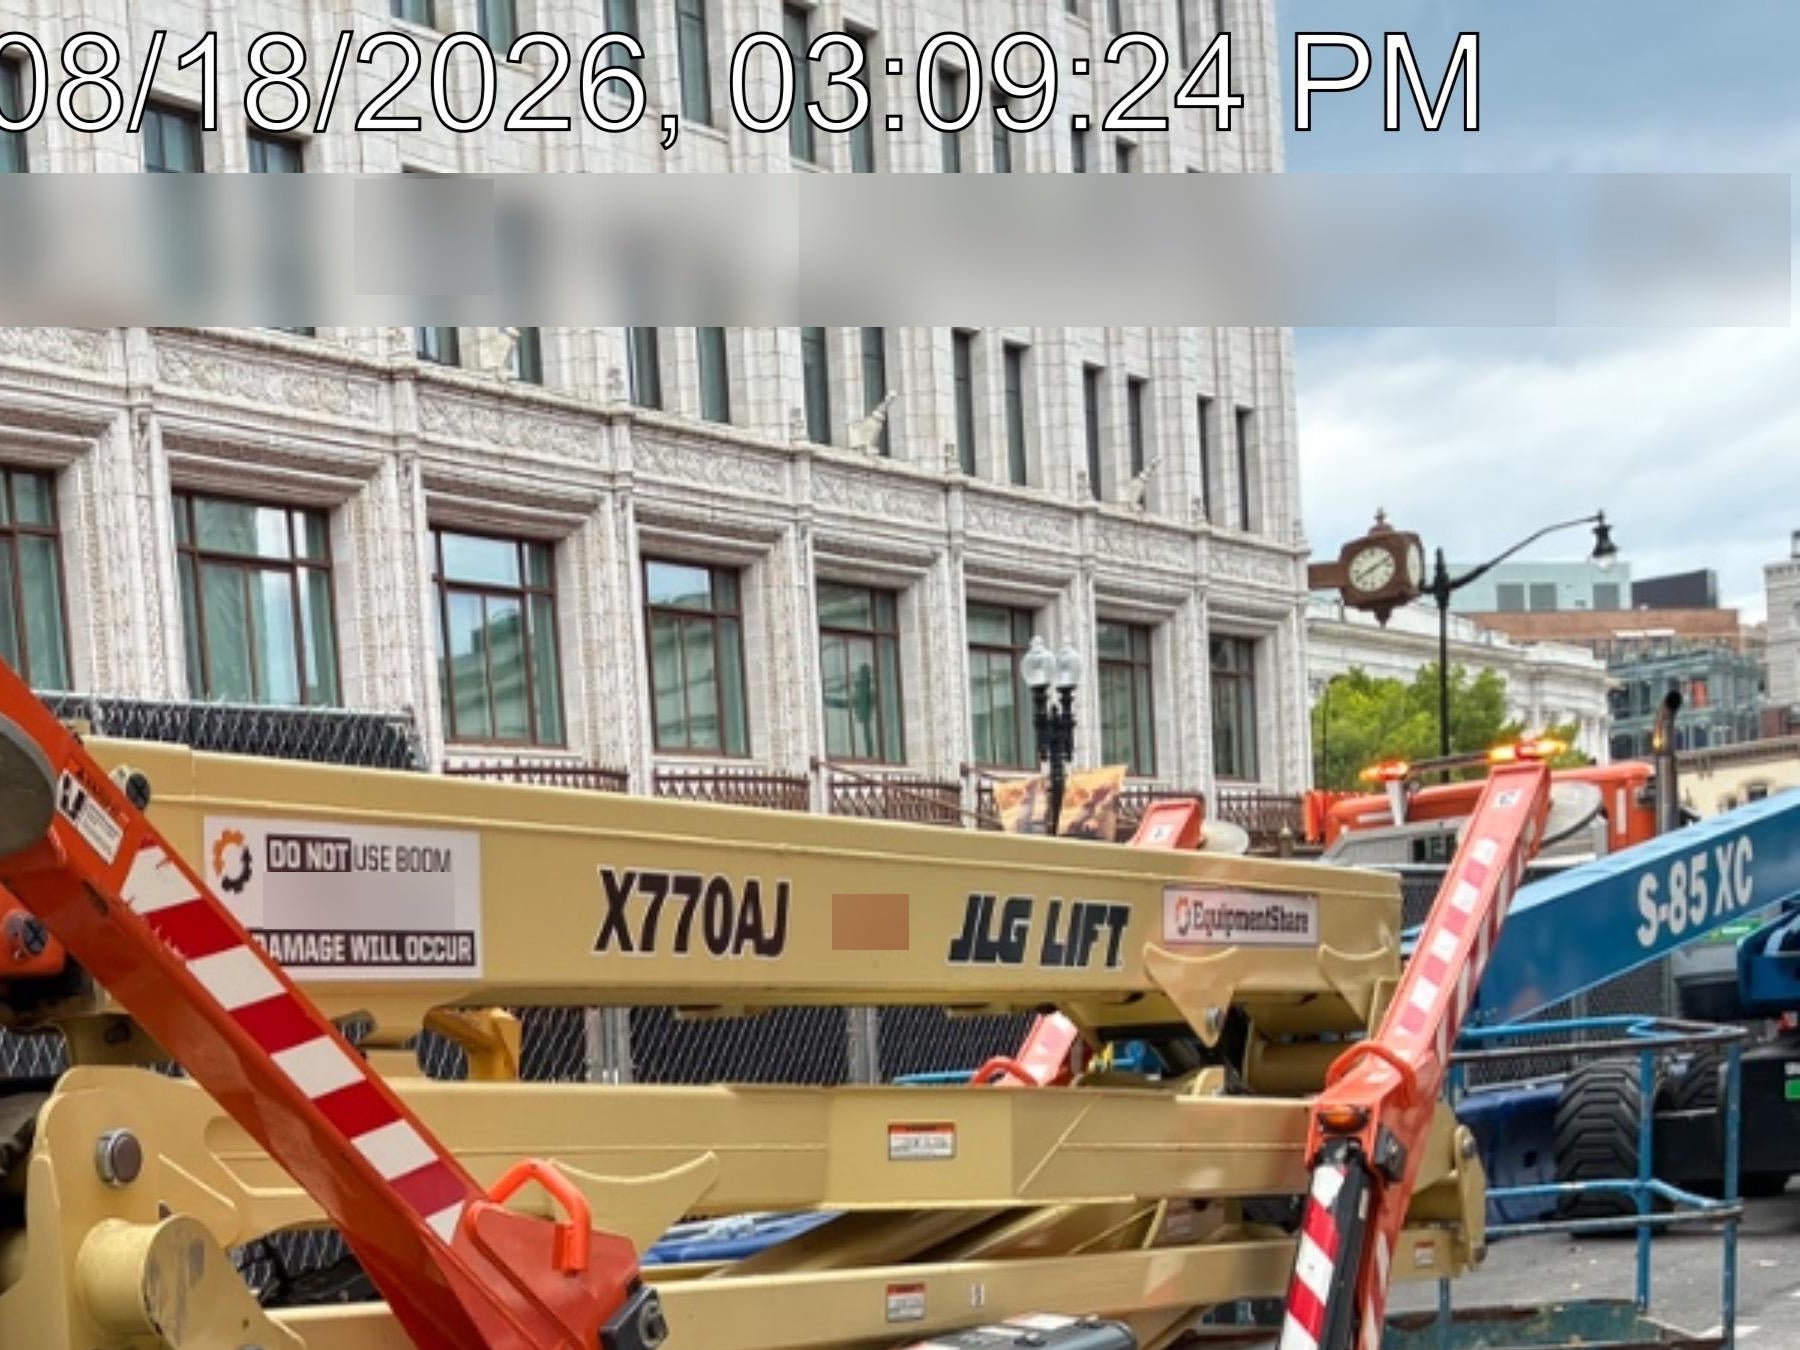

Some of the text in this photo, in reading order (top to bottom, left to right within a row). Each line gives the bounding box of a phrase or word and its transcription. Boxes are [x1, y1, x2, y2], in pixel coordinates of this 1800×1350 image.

[269, 839, 451, 873] DO NOT USE BOOM
[592, 865, 790, 961] X770AJ
[1192, 900, 1309, 938] EquipmentShare
[1636, 833, 1754, 948] S-85 XC
[349, 934, 402, 962] WILL
[404, 935, 473, 963] OCCUR
[947, 891, 1134, 972] JLG LIFT
